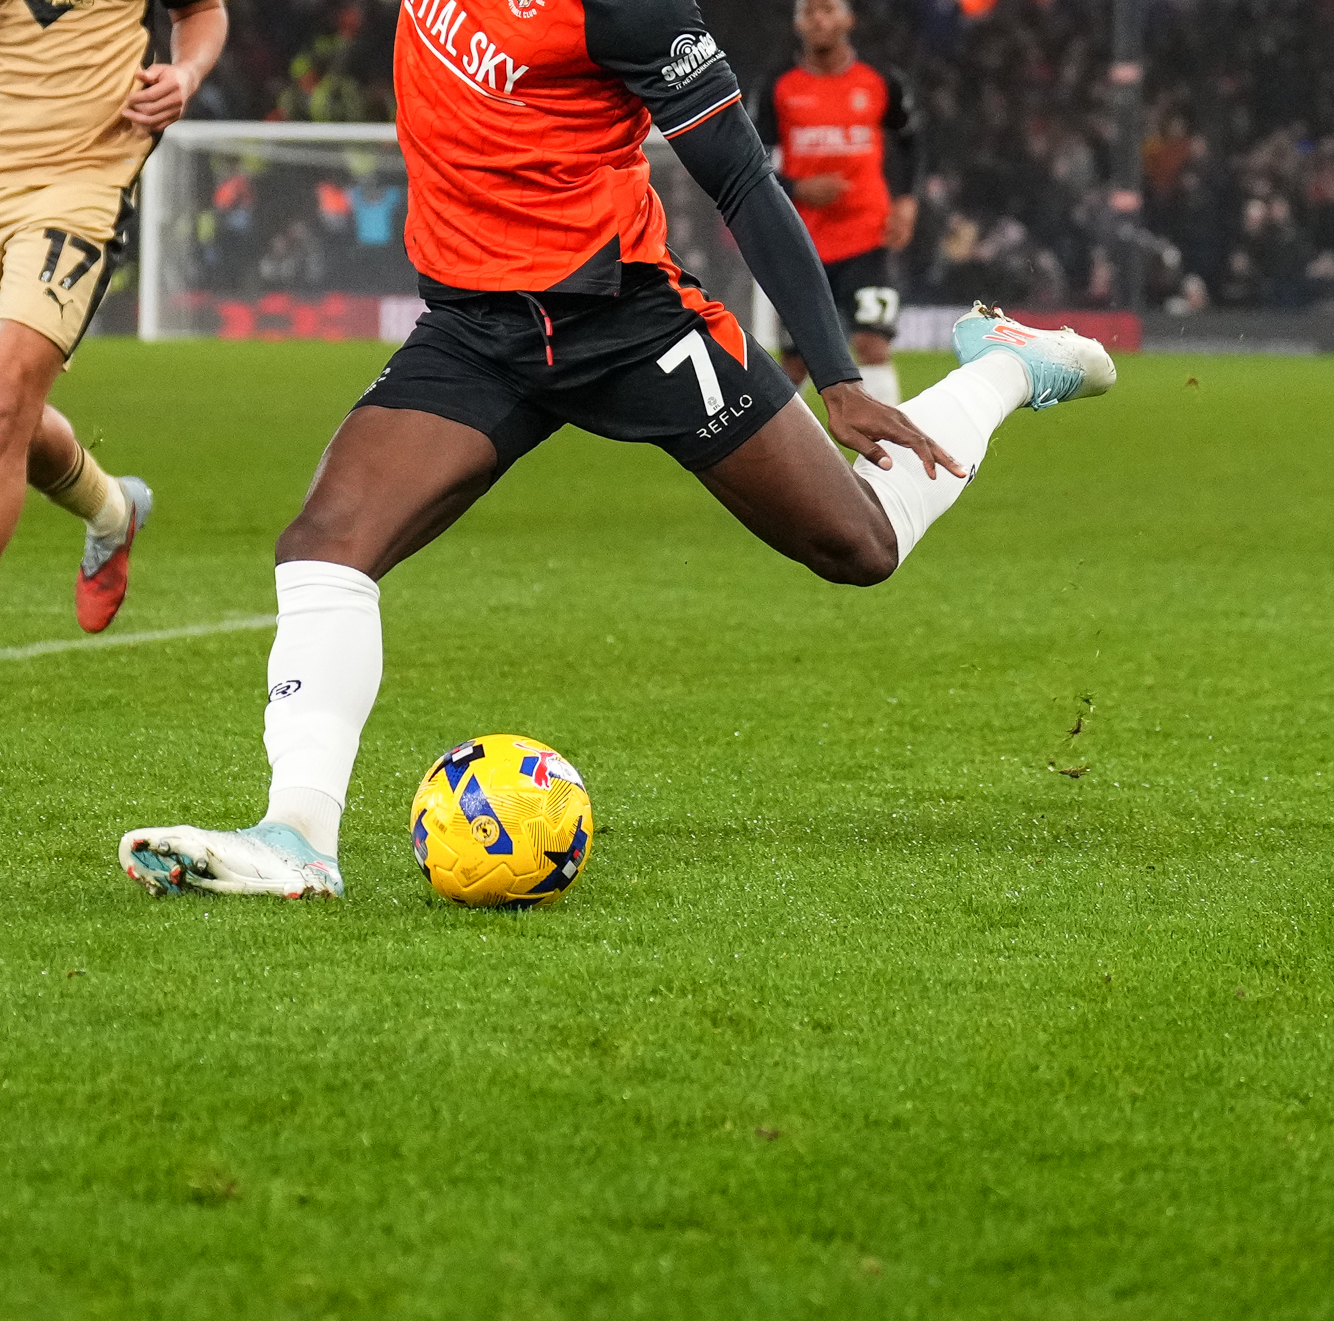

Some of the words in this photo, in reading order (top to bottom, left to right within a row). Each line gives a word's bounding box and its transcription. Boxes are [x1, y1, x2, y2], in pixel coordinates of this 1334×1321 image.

[462, 31, 529, 95] SKY
[41, 228, 101, 292] 17
[656, 329, 725, 417] 7
[696, 394, 753, 439] REFLO
